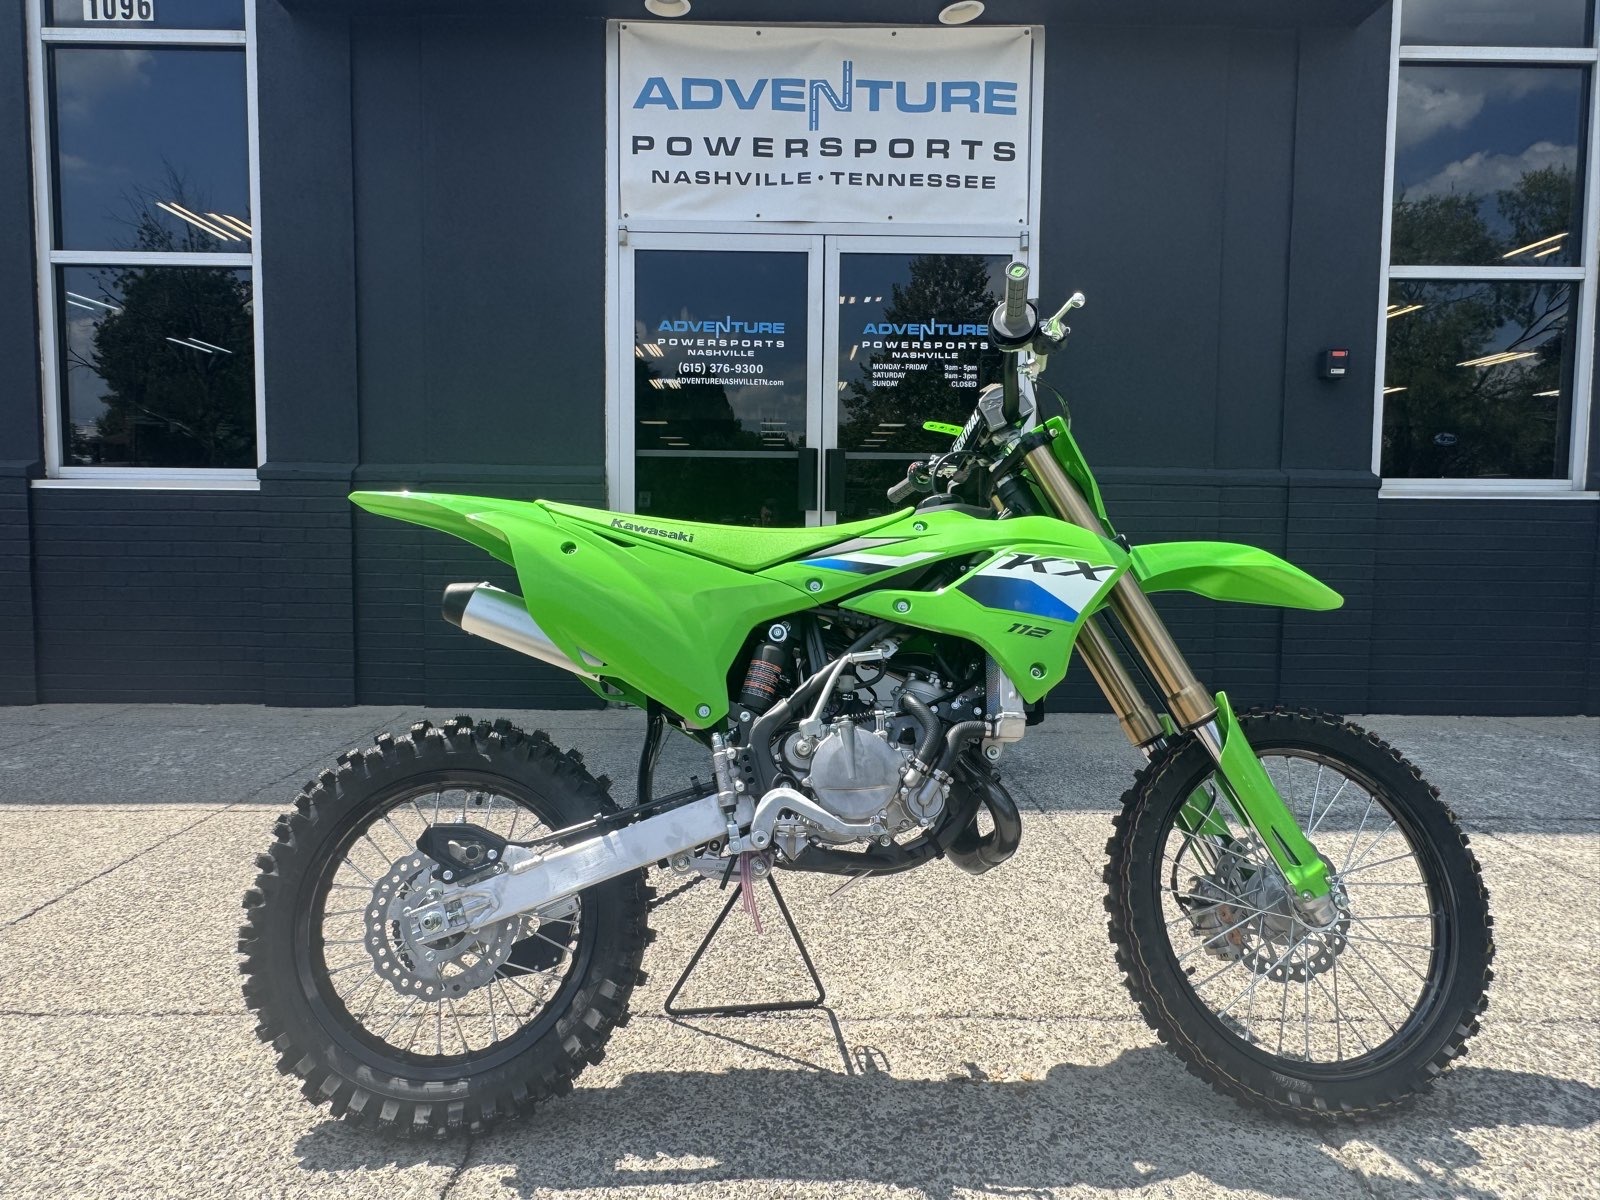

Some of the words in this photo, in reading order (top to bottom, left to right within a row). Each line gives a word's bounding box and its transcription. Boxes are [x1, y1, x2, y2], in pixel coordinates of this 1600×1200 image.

[90, 0, 151, 19] 1096
[633, 60, 1018, 131] ADVENTURE
[632, 135, 1016, 162] POWERSPORTS
[651, 170, 812, 187] NASHVILLE
[830, 171, 996, 190] TENNESSEE
[658, 316, 785, 338] ADVENTURE
[863, 318, 988, 341] ADVENTURE
[657, 338, 785, 348] POWERSPORTS
[862, 341, 989, 350] POWERSPORTS
[687, 349, 755, 357] NASHVILLE
[678, 362, 706, 375] (615)
[709, 363, 764, 374] 376-9300
[657, 377, 784, 386] wwwADVENTURENASHVILLETN.com
[611, 518, 694, 542] Kawasaki
[997, 554, 1118, 582] KX
[1008, 623, 1052, 638] 112
